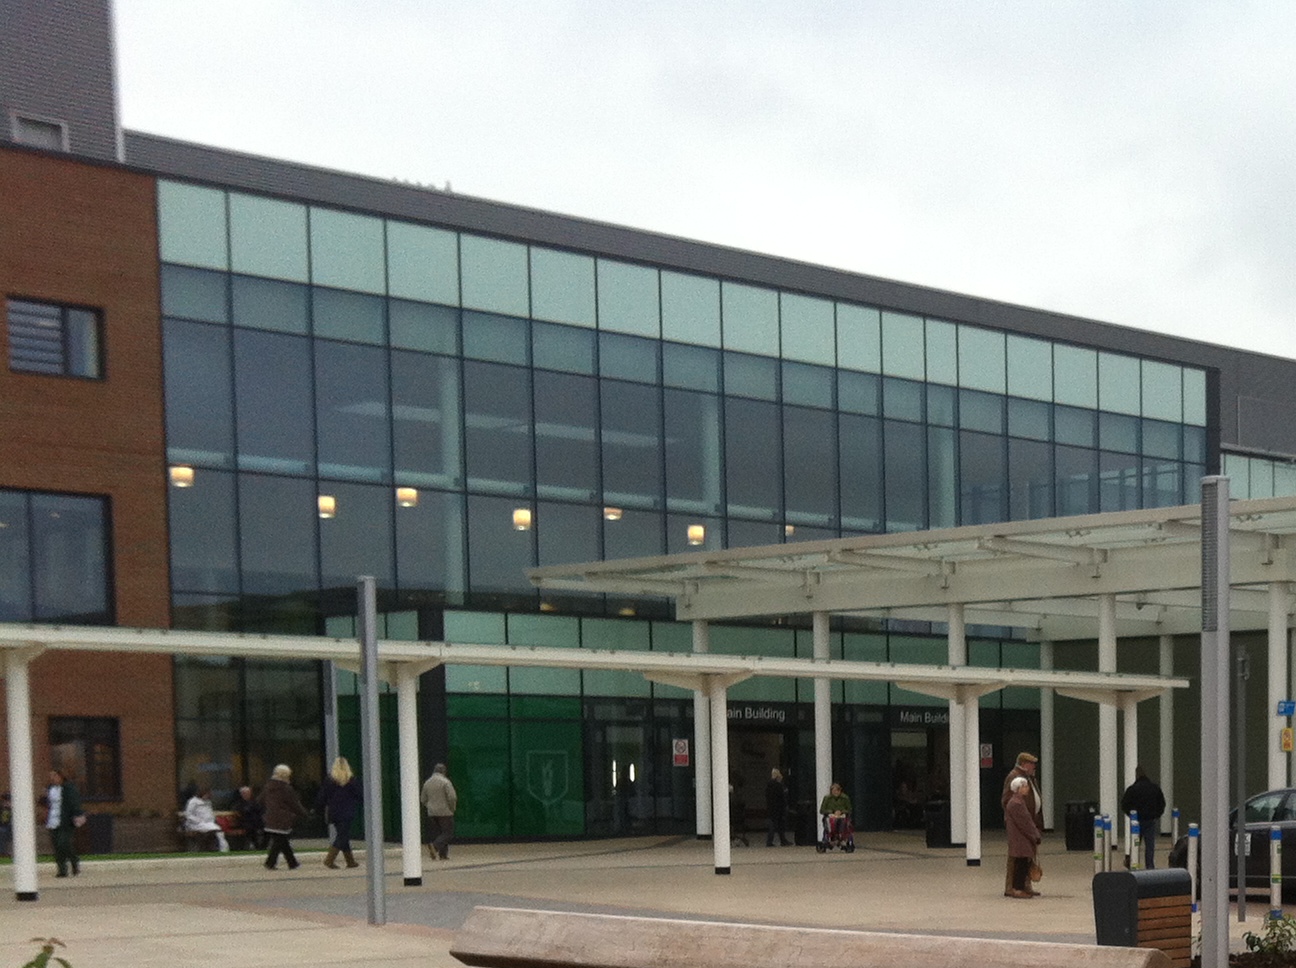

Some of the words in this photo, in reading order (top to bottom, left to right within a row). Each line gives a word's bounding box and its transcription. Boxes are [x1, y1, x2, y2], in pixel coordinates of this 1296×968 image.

[727, 707, 742, 719] ain
[745, 707, 785, 722] Building
[901, 711, 922, 723] Main
